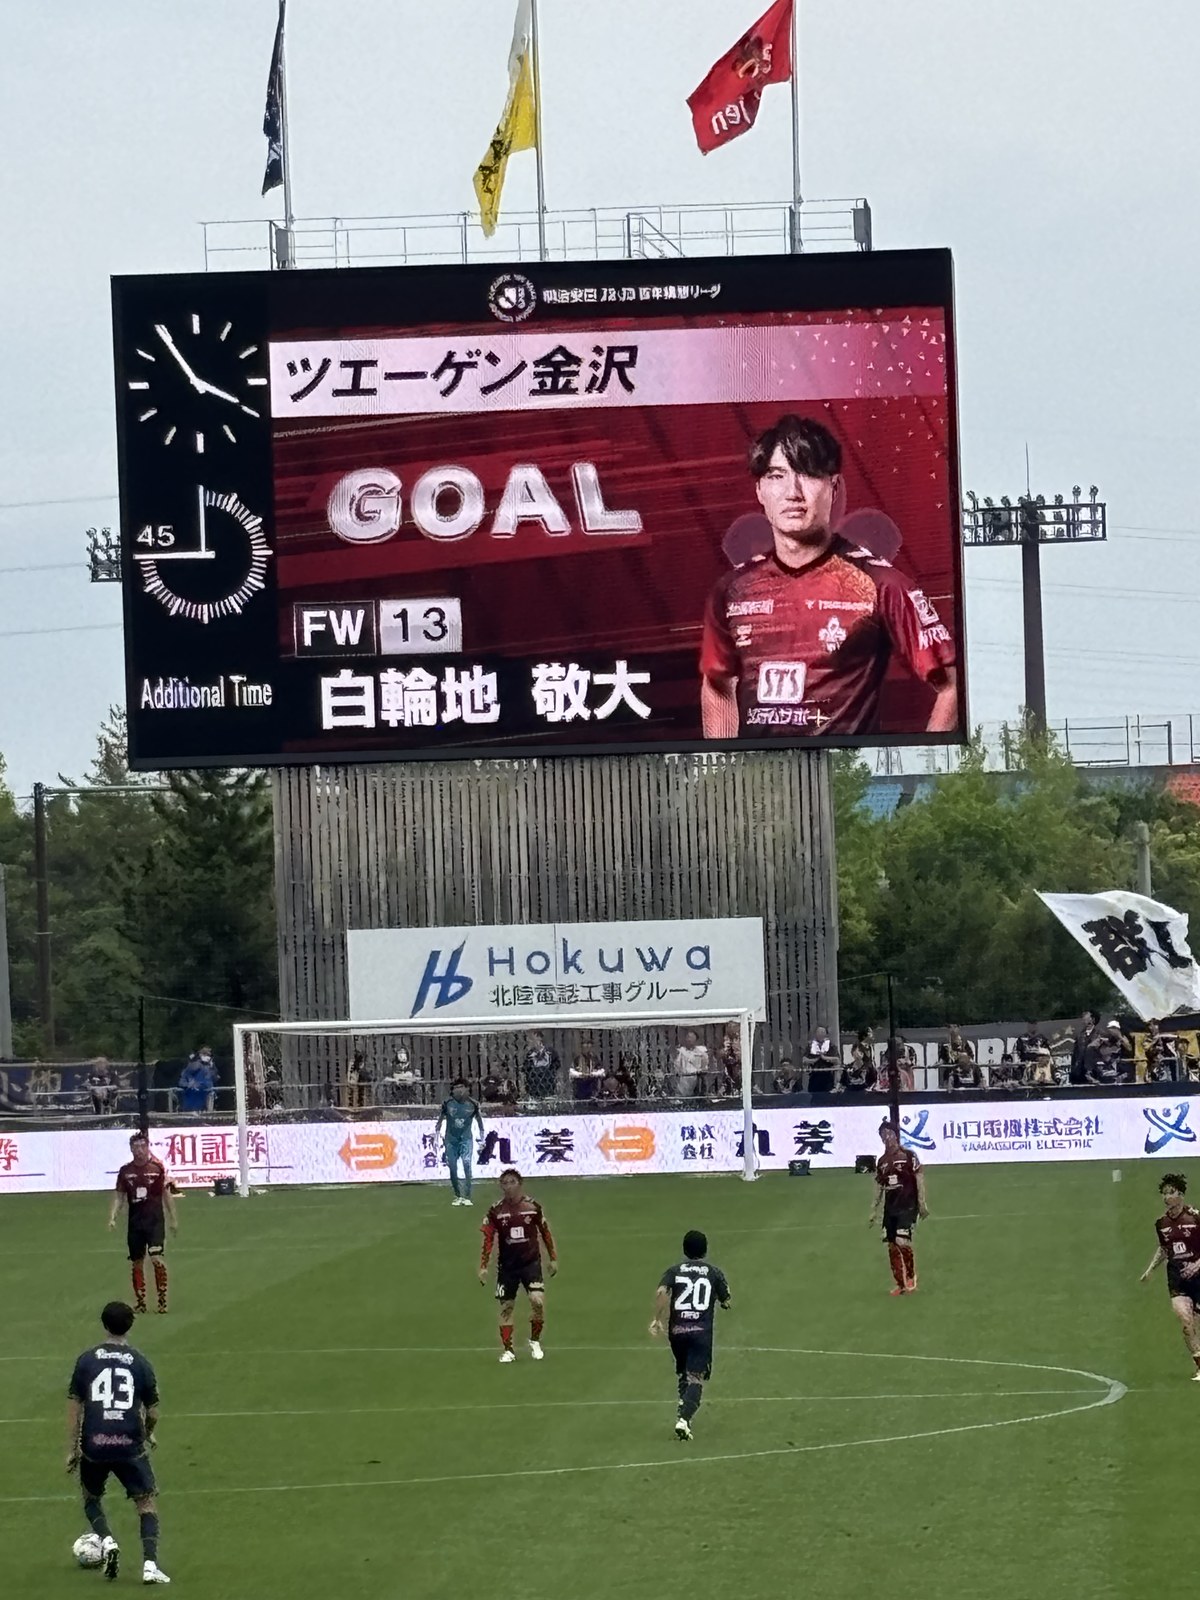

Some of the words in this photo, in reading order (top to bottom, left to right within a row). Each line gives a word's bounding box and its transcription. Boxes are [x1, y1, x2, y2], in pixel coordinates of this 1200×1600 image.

[286, 344, 639, 402] ツエーゲン金沢
[327, 460, 643, 544] GOAL
[137, 525, 175, 547] 45
[302, 608, 364, 647] FW
[393, 607, 448, 643] 13
[141, 675, 225, 709] Additional
[229, 674, 273, 707] Time
[321, 663, 500, 730] 白輪地
[531, 659, 652, 723] 敬大
[761, 666, 801, 699] STS
[487, 937, 712, 977] Hokuwa
[674, 1275, 712, 1311] 20
[92, 1367, 135, 1410] 43
